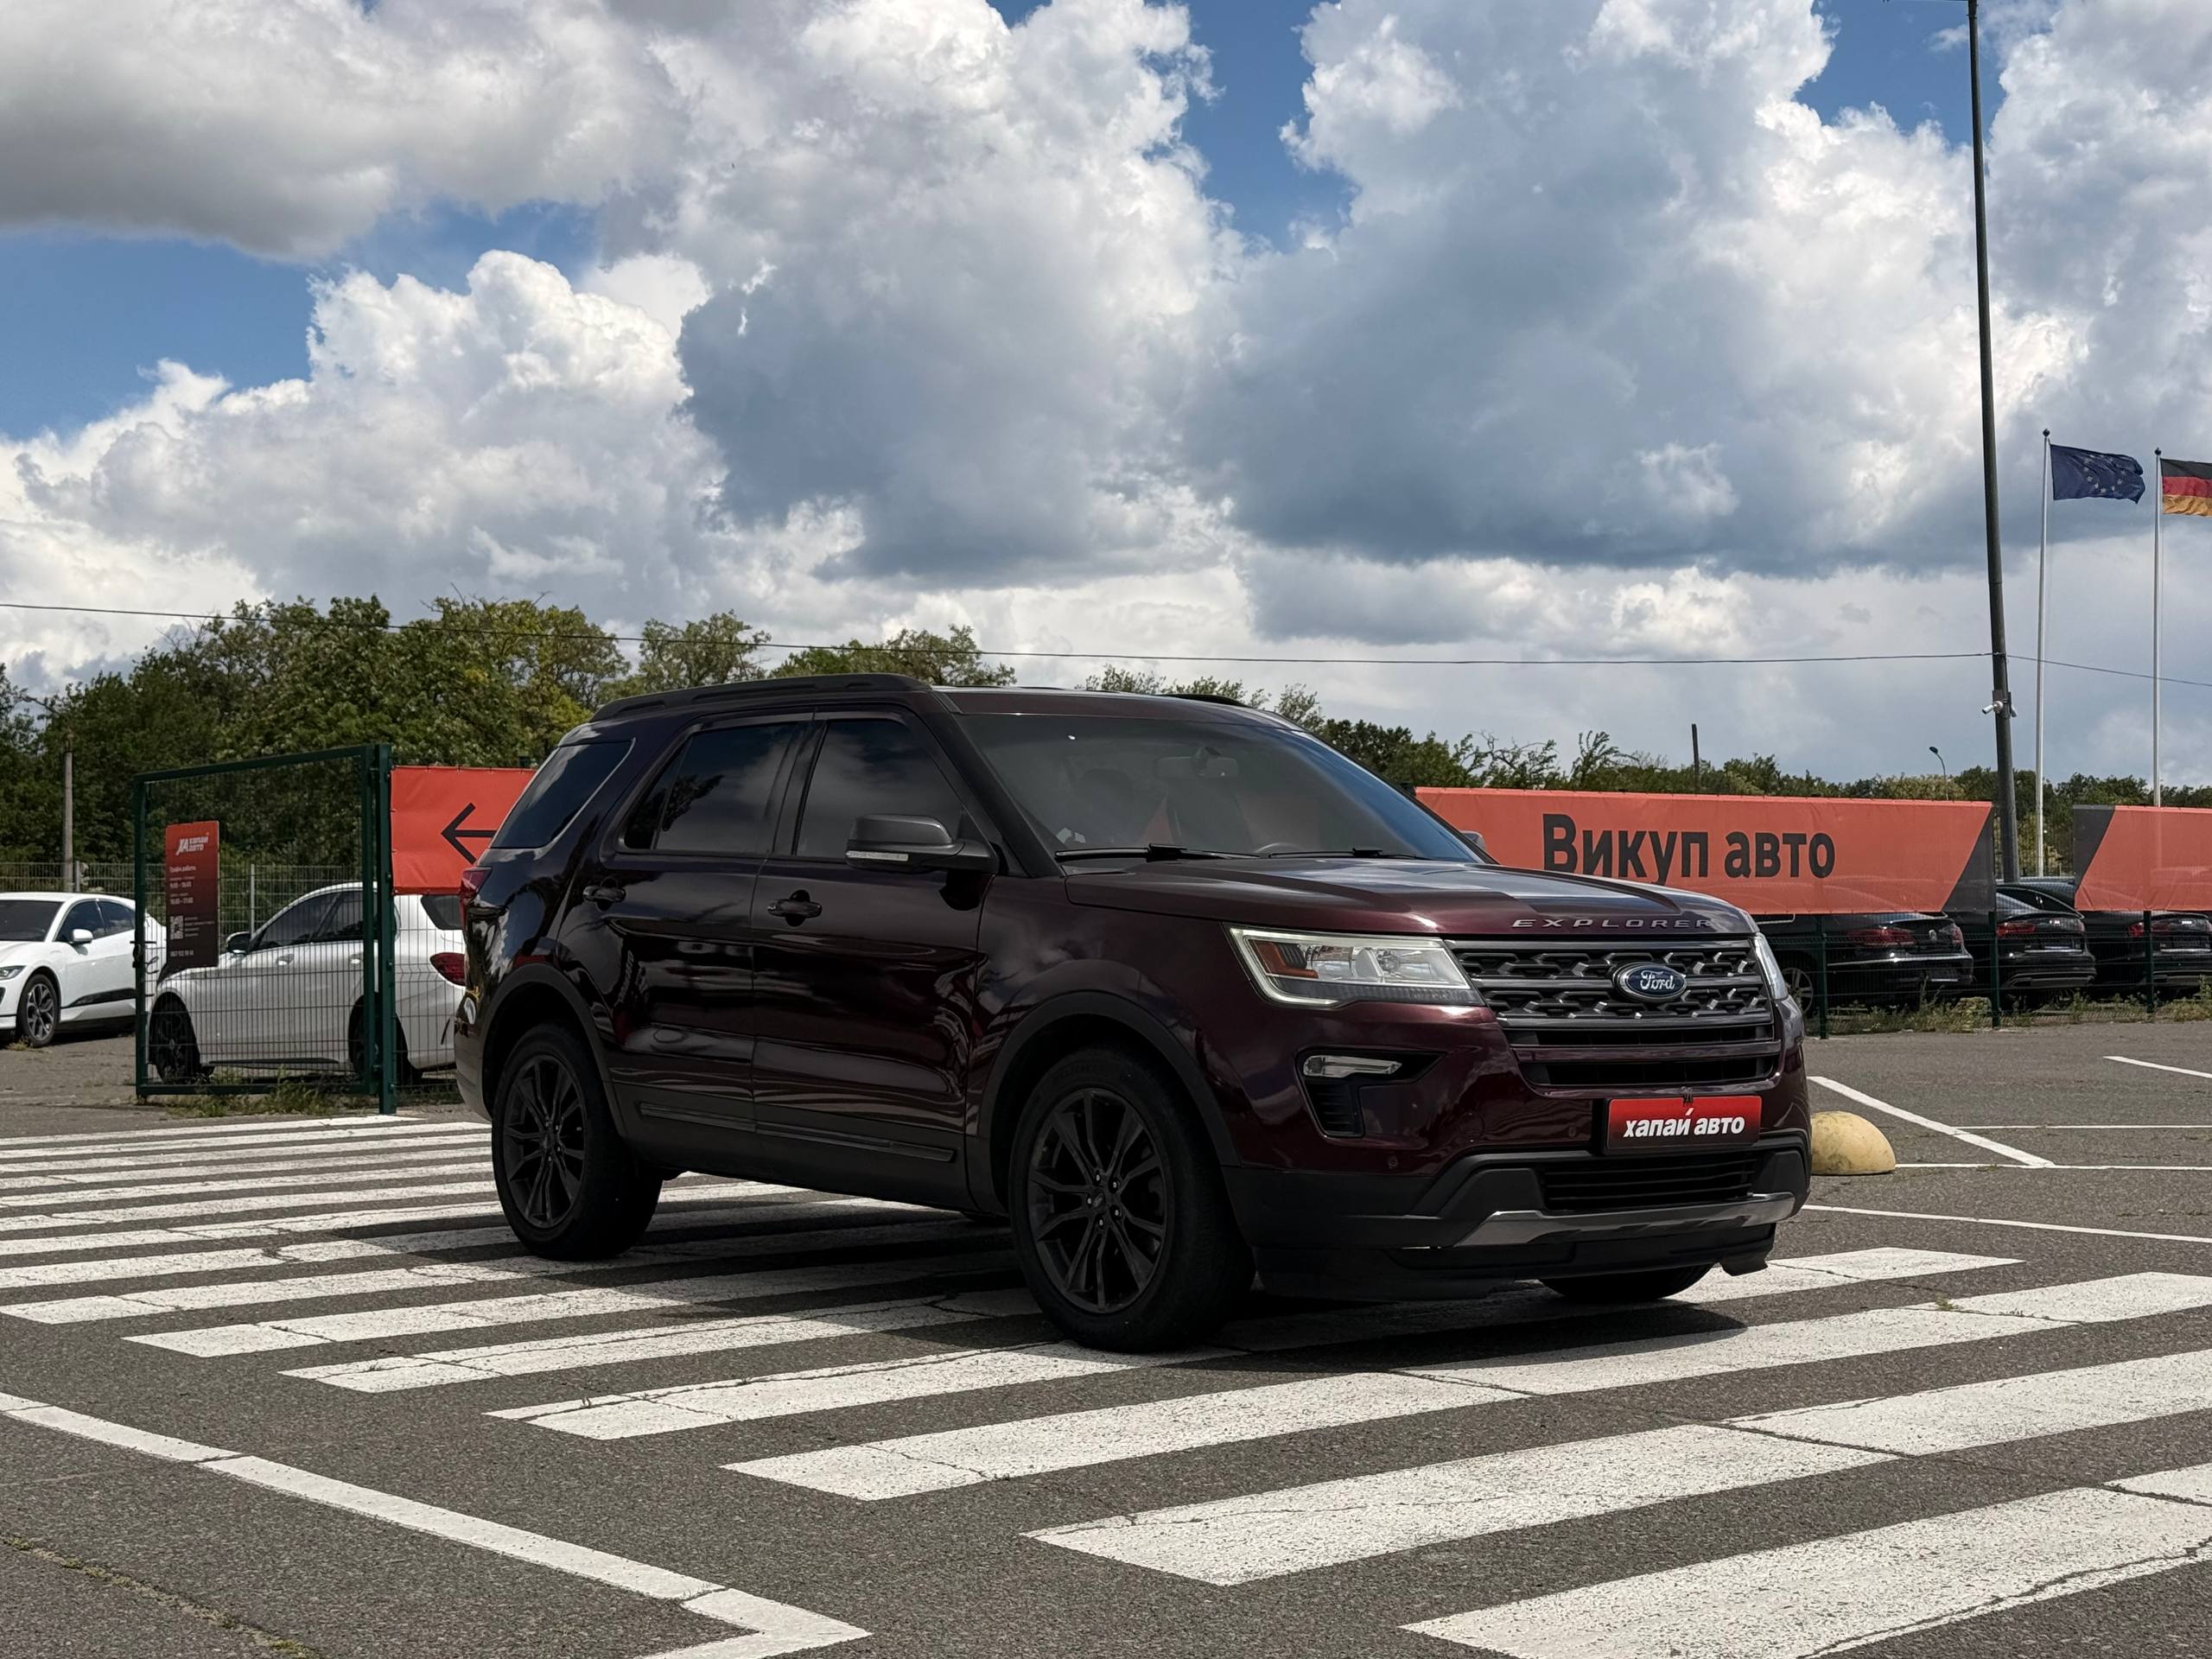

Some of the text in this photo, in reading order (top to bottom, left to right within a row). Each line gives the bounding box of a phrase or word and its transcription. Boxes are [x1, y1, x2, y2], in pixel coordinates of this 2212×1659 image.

[1542, 813, 1835, 885] Викуп авто
[1512, 918, 1713, 929] EXPLORER
[1640, 969, 1676, 991] Ford
[1623, 1107, 1745, 1138] хапай авто
